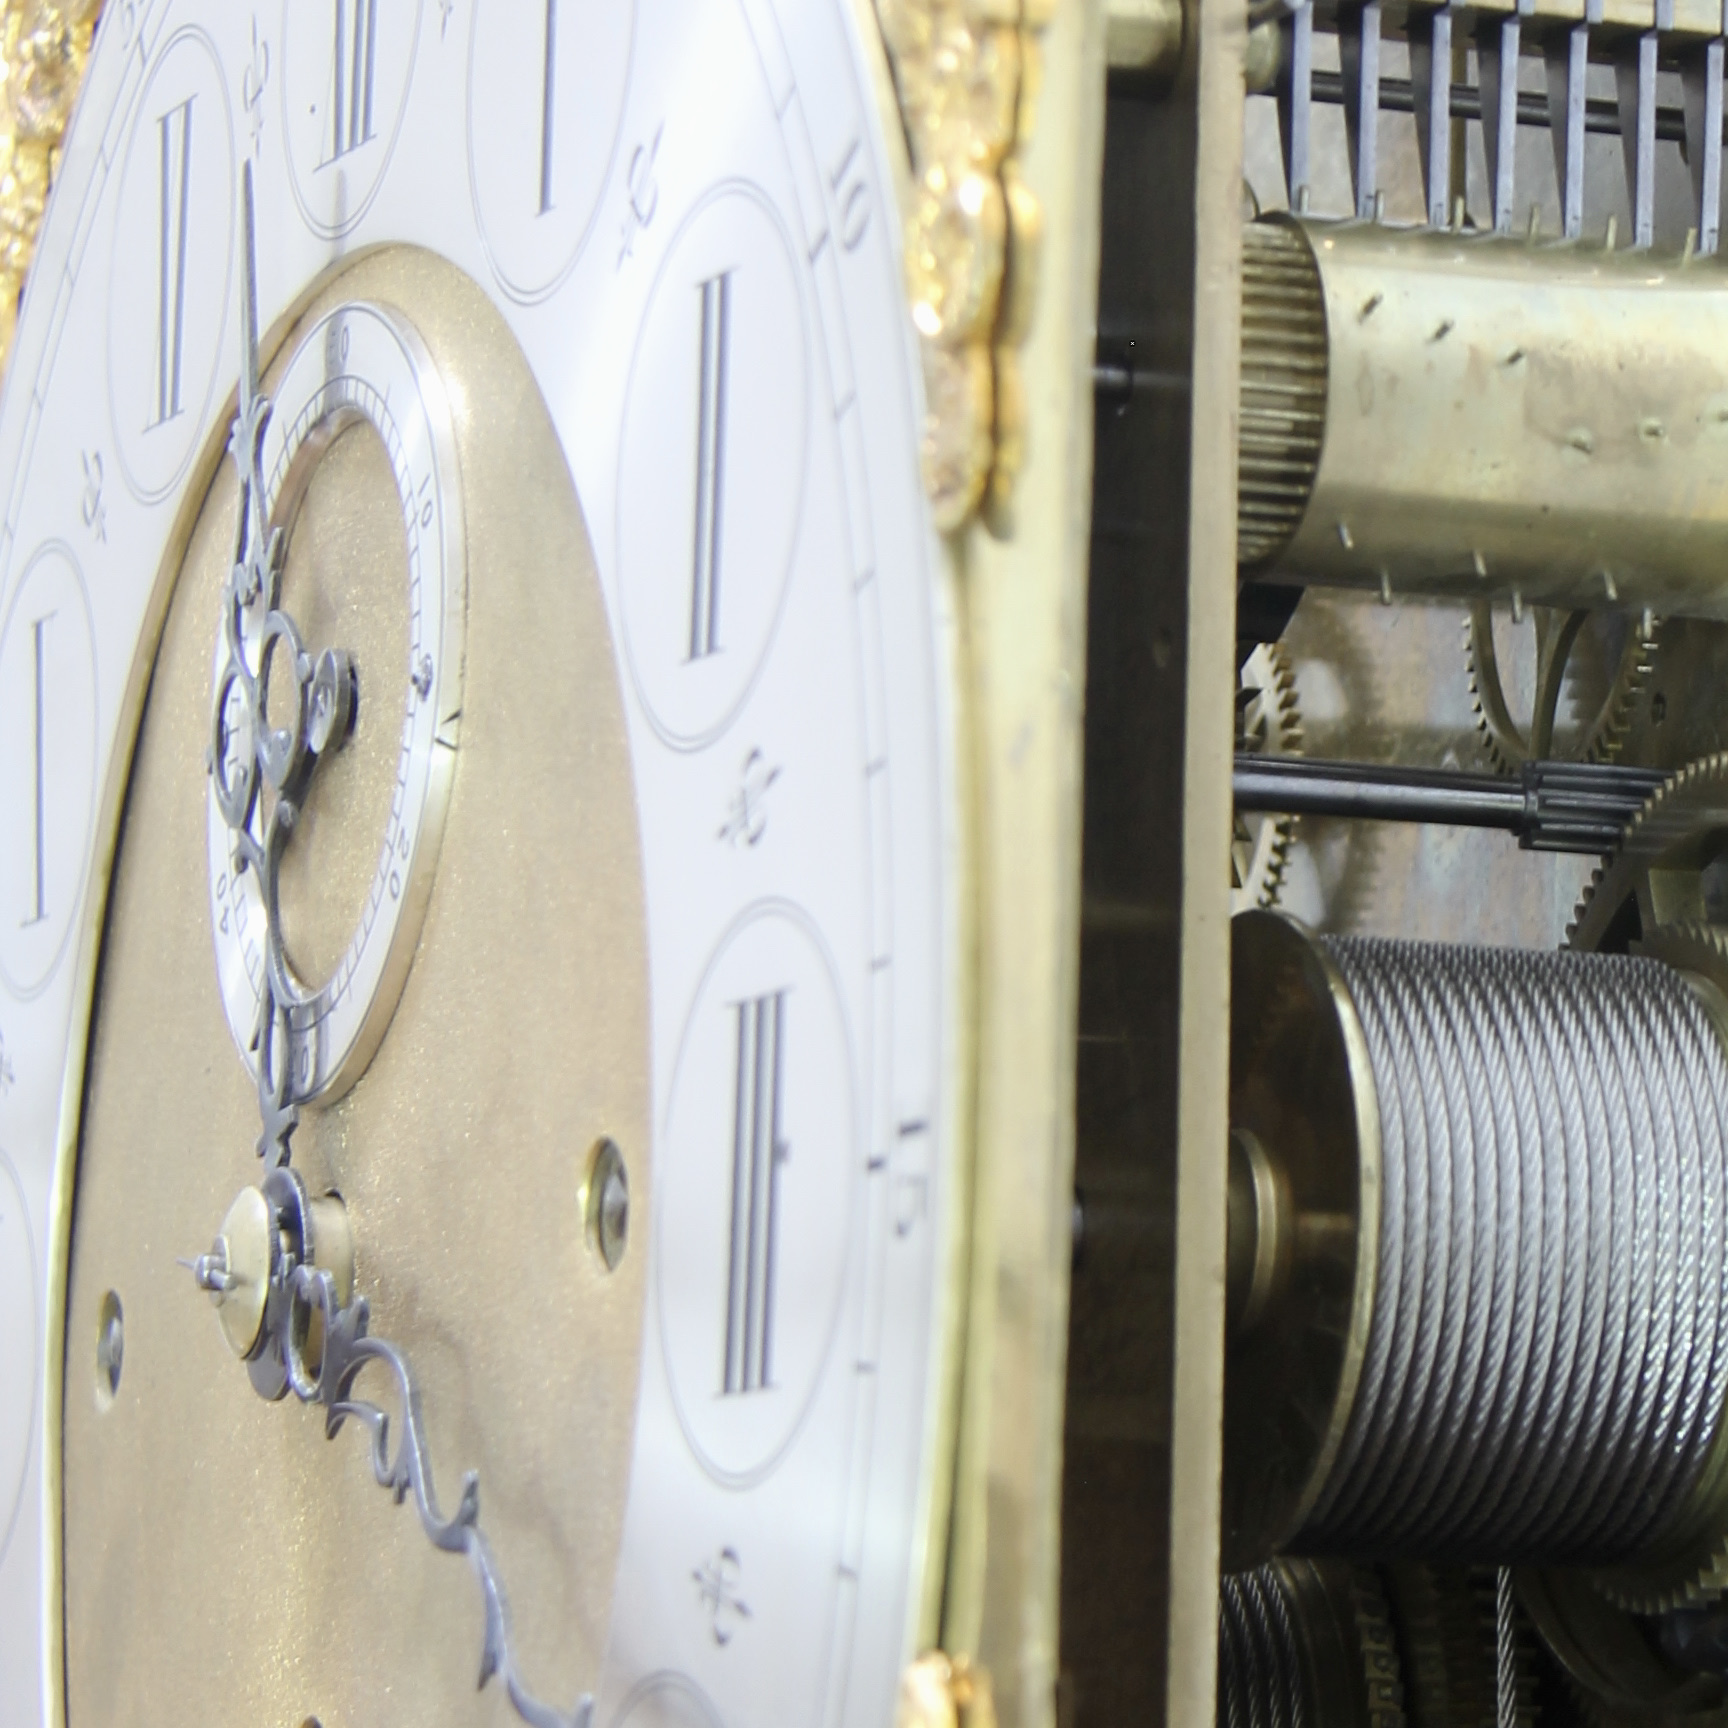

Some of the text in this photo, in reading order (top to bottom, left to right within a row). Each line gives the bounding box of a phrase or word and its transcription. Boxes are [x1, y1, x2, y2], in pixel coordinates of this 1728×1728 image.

[830, 136, 871, 253] 10
[417, 471, 434, 529] 10
[388, 826, 410, 901] 20
[216, 871, 230, 935] 40
[711, 987, 793, 1398] III
